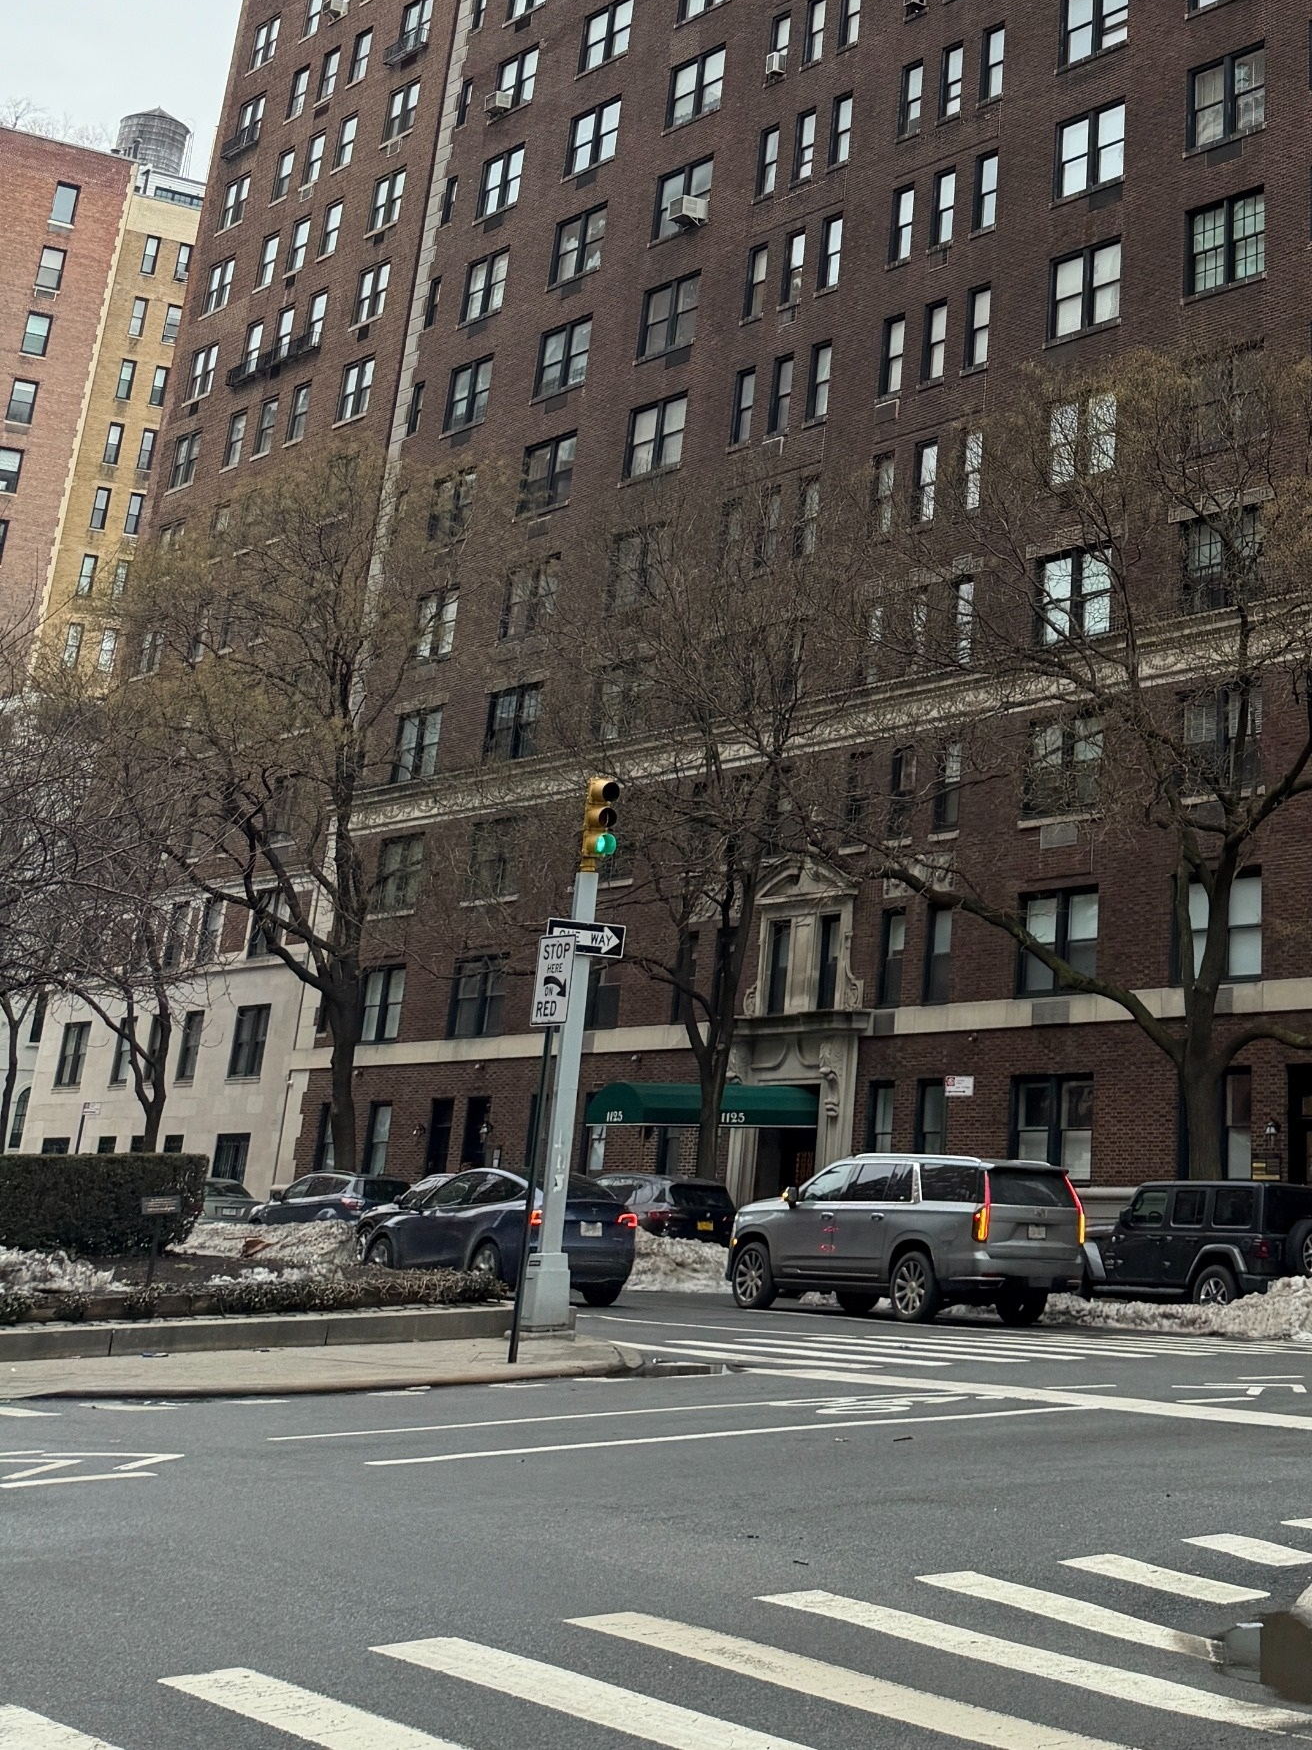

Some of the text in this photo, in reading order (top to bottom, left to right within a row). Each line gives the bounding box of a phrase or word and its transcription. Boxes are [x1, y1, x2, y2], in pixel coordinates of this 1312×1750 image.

[591, 932, 613, 947] WAY
[543, 942, 571, 960] STOP
[546, 962, 563, 973] HERE
[544, 986, 554, 997] ON
[535, 1000, 557, 1018] RED
[606, 1110, 623, 1122] 1125
[720, 1112, 746, 1123] 1125
